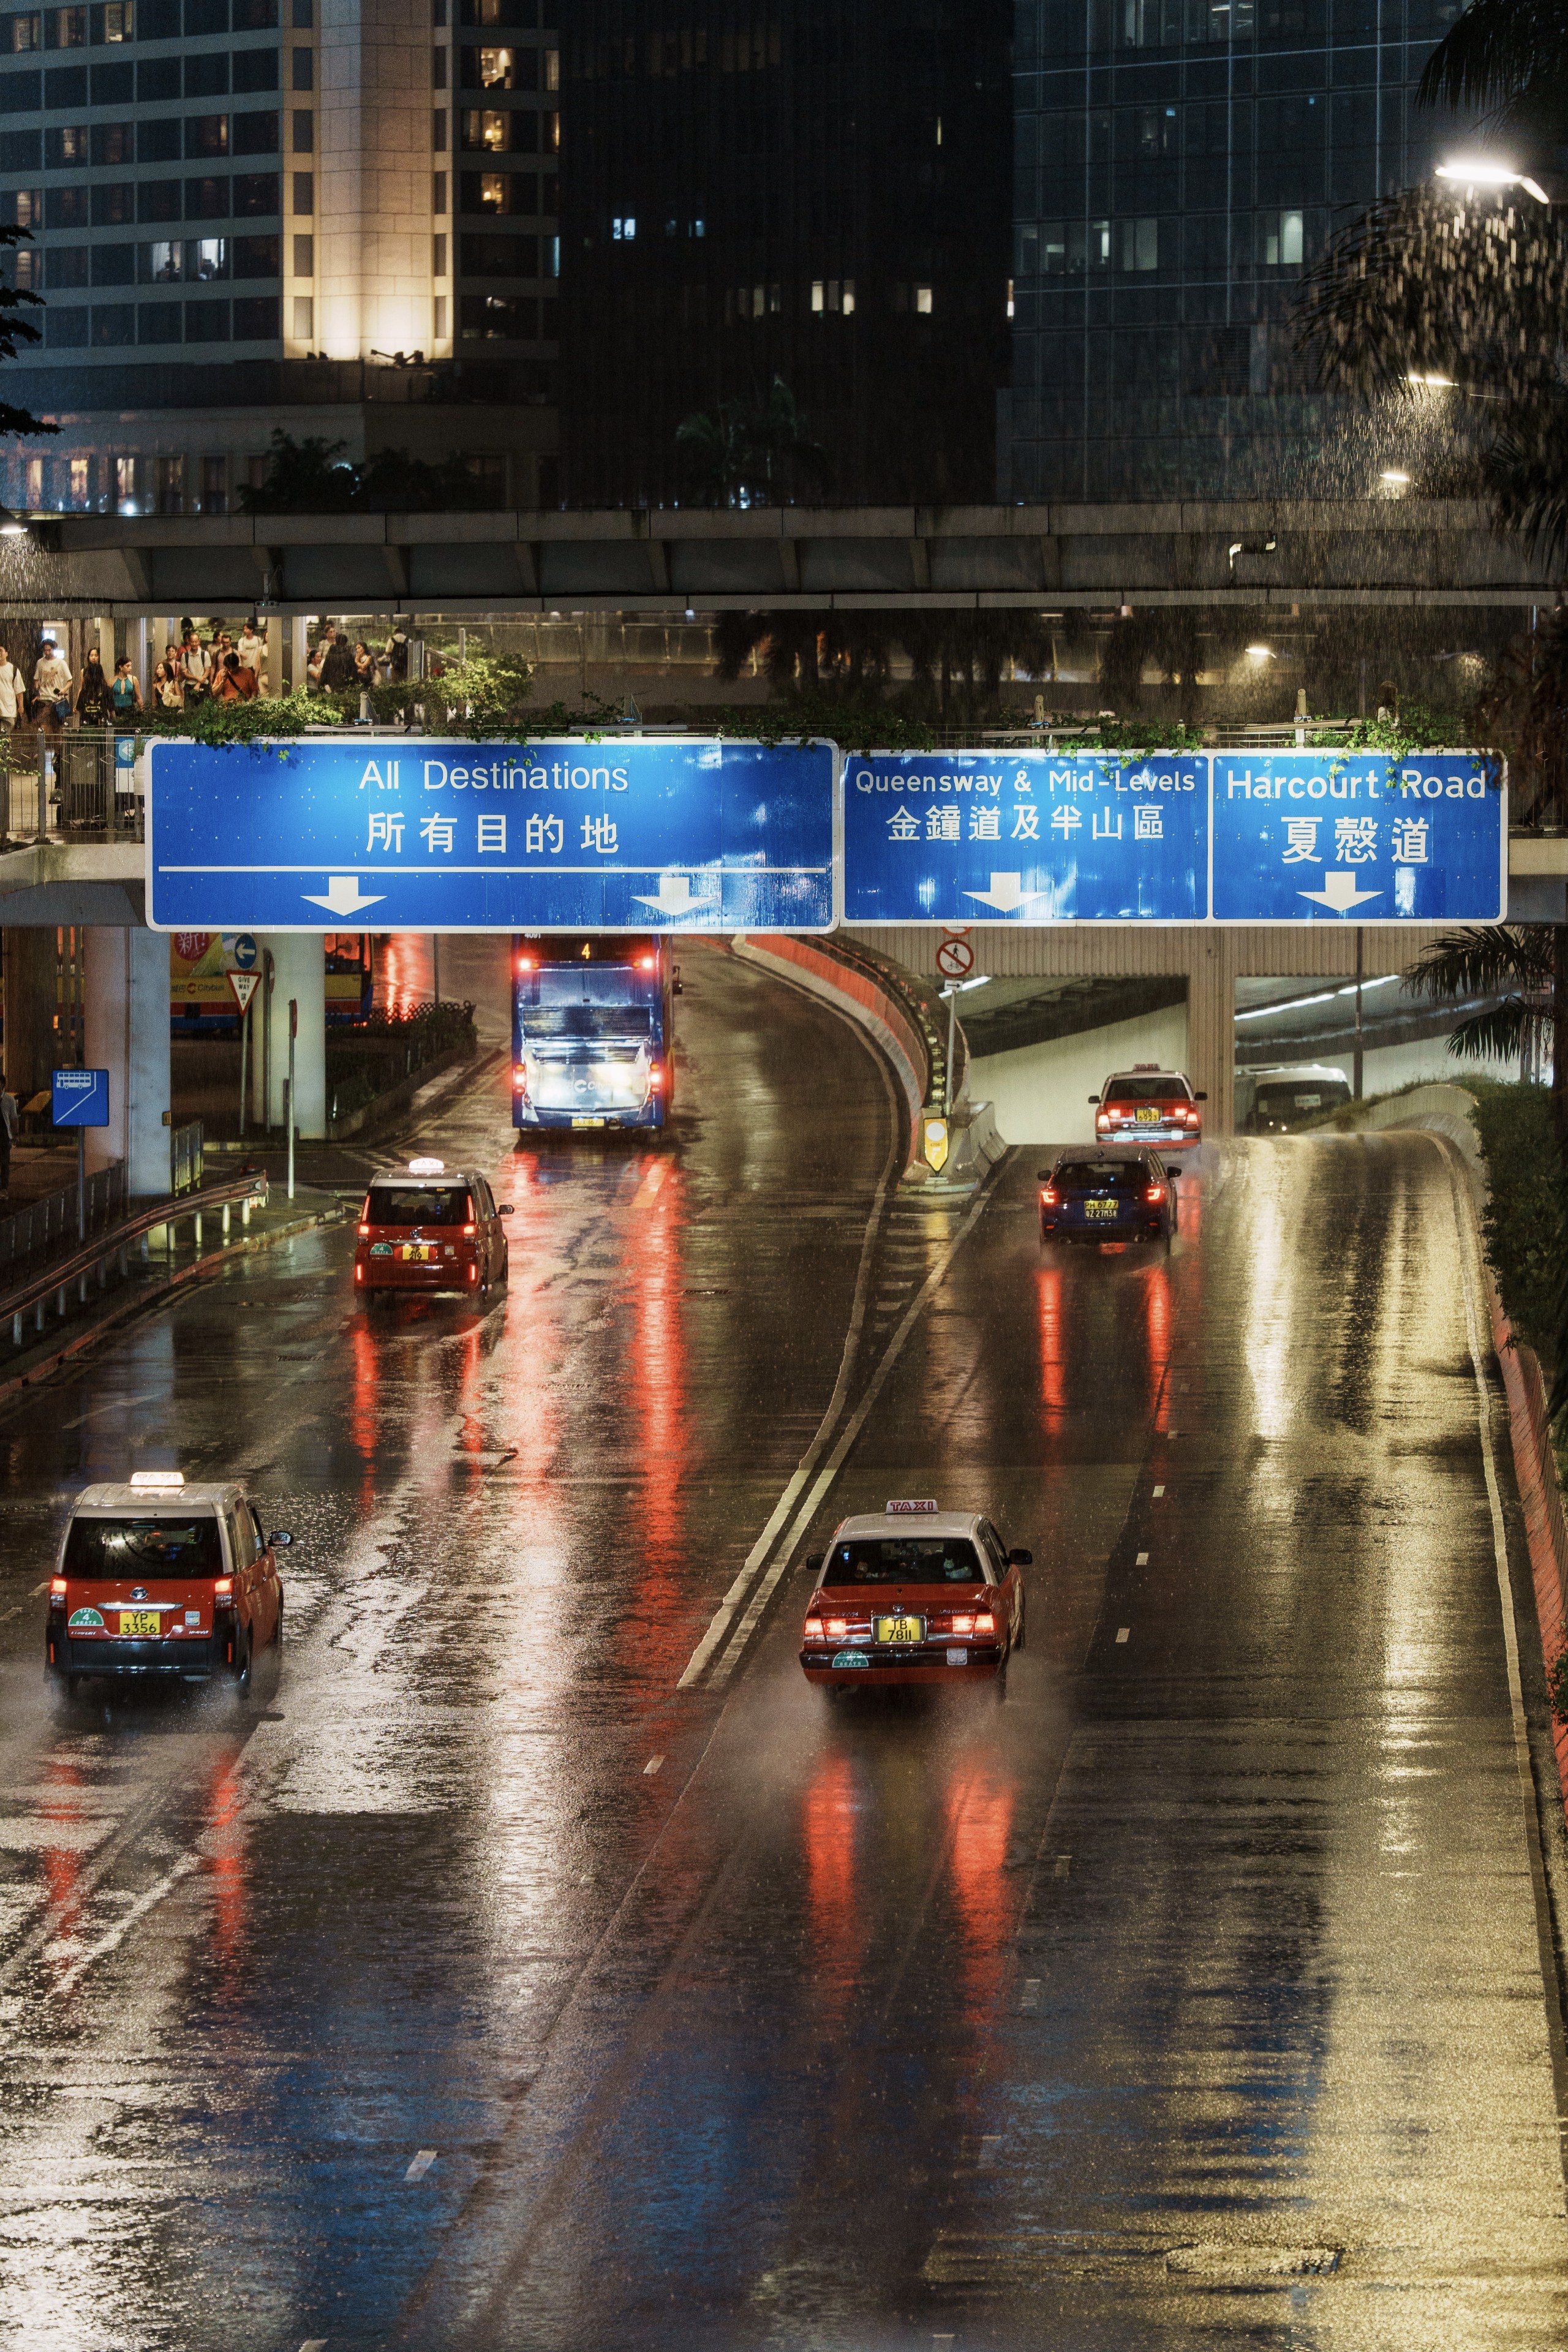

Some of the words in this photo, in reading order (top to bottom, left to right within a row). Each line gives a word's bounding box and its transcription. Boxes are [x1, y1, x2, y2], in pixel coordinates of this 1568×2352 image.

[358, 760, 399, 790] All
[424, 760, 628, 792] Destinations
[856, 770, 1003, 796] Queensway
[1014, 770, 1033, 793] &
[1227, 769, 1381, 799] Harcourt
[1401, 769, 1486, 799] Road
[885, 804, 1164, 841] 金鐘道及半山區
[366, 812, 620, 854] 所有目的地
[581, 943, 590, 959] 4
[197, 984, 225, 992] Citybus
[137, 1474, 178, 1483] TAXI
[890, 1501, 933, 1512] TAXI
[132, 1613, 148, 1623] YP
[123, 1624, 157, 1634] 3356
[891, 1619, 908, 1629] TB
[888, 1630, 912, 1640] 7811
